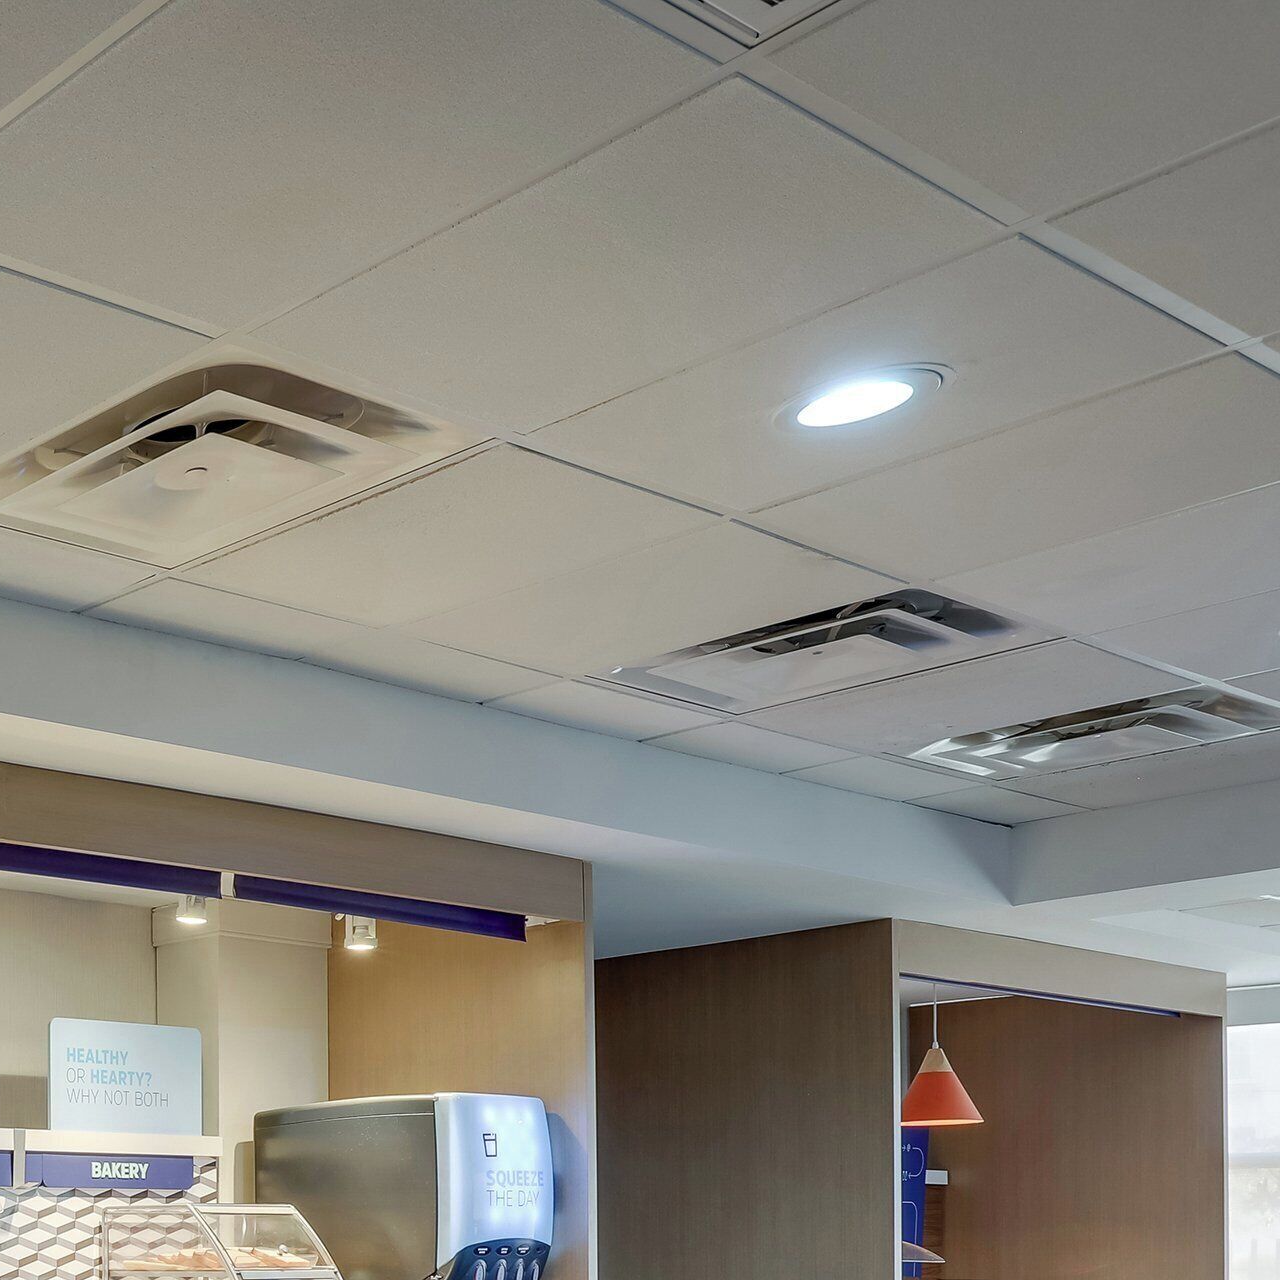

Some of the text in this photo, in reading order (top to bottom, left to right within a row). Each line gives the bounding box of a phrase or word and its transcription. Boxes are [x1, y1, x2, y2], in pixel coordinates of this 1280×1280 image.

[66, 1047, 129, 1066] HEALTHY
[66, 1067, 153, 1087] OR HEARTY?
[66, 1087, 169, 1107] WHY NOT BOTH
[91, 1161, 149, 1179] BAKERY
[486, 1170, 544, 1187] SQUEEZE
[486, 1190, 539, 1206] THE DAY
